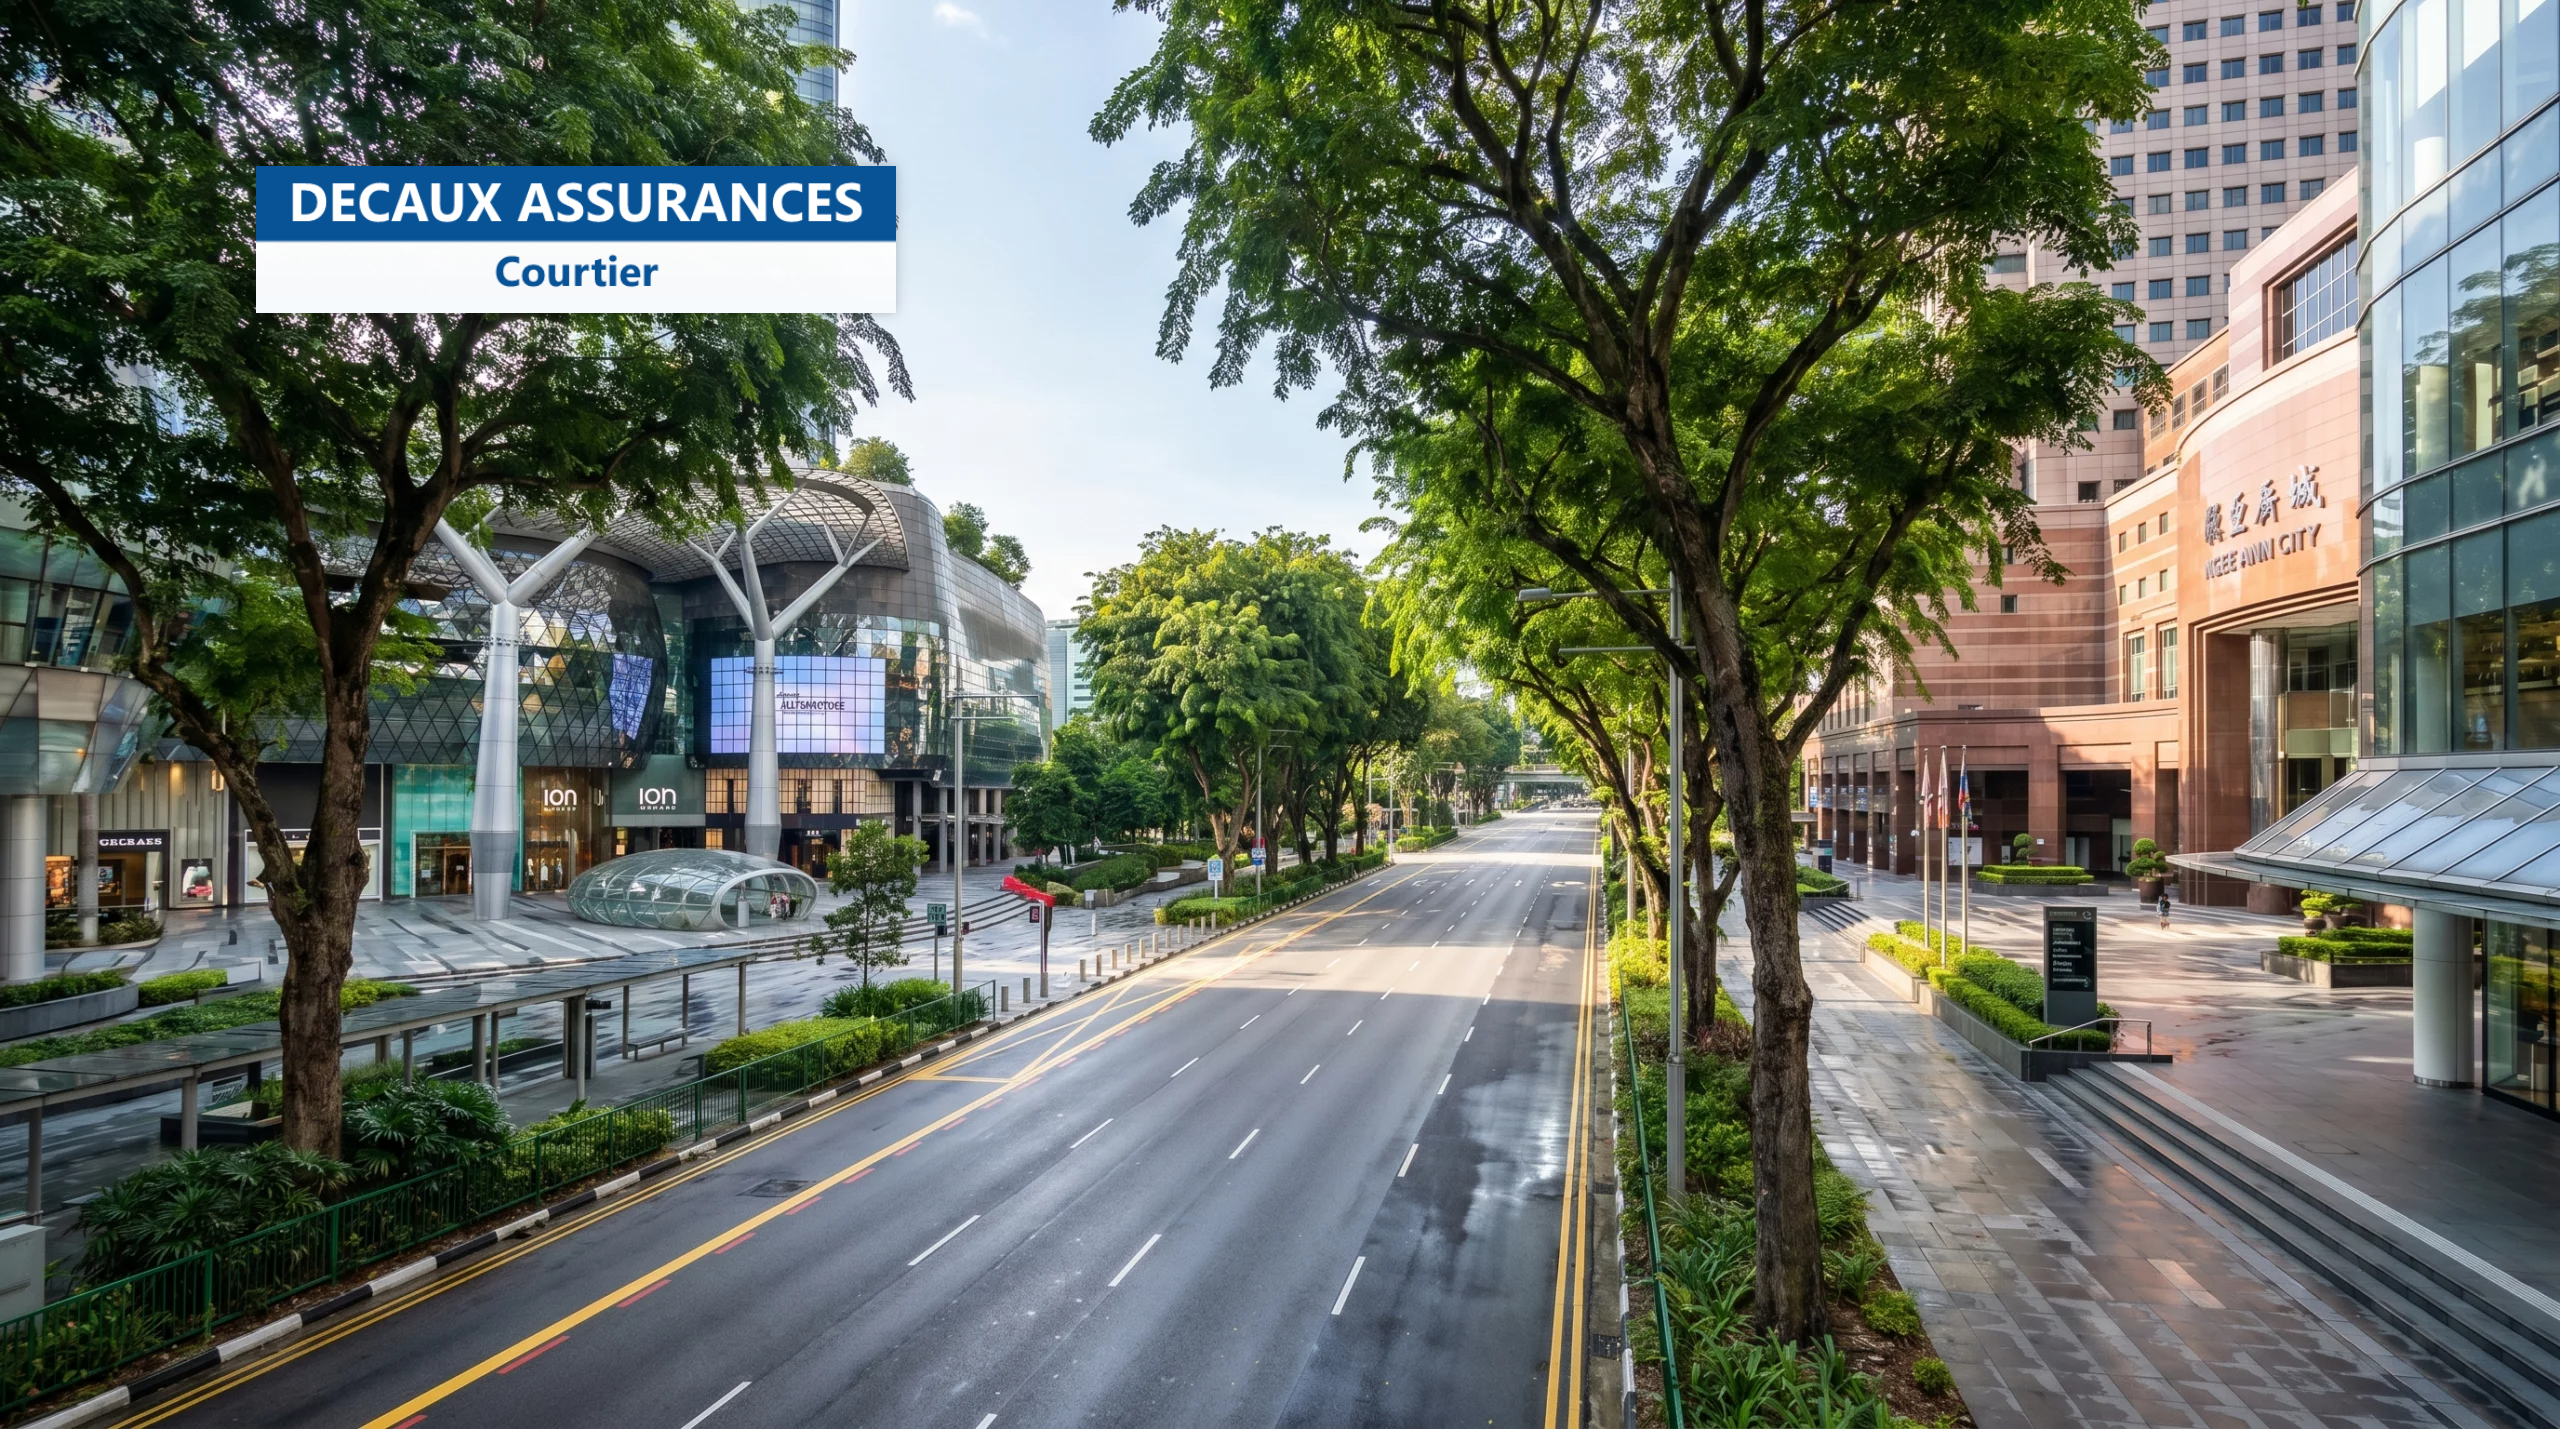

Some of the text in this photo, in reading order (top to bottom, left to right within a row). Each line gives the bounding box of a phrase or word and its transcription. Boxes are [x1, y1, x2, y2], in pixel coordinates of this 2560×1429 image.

[2205, 523, 2321, 580] NGEE ANN CITY
